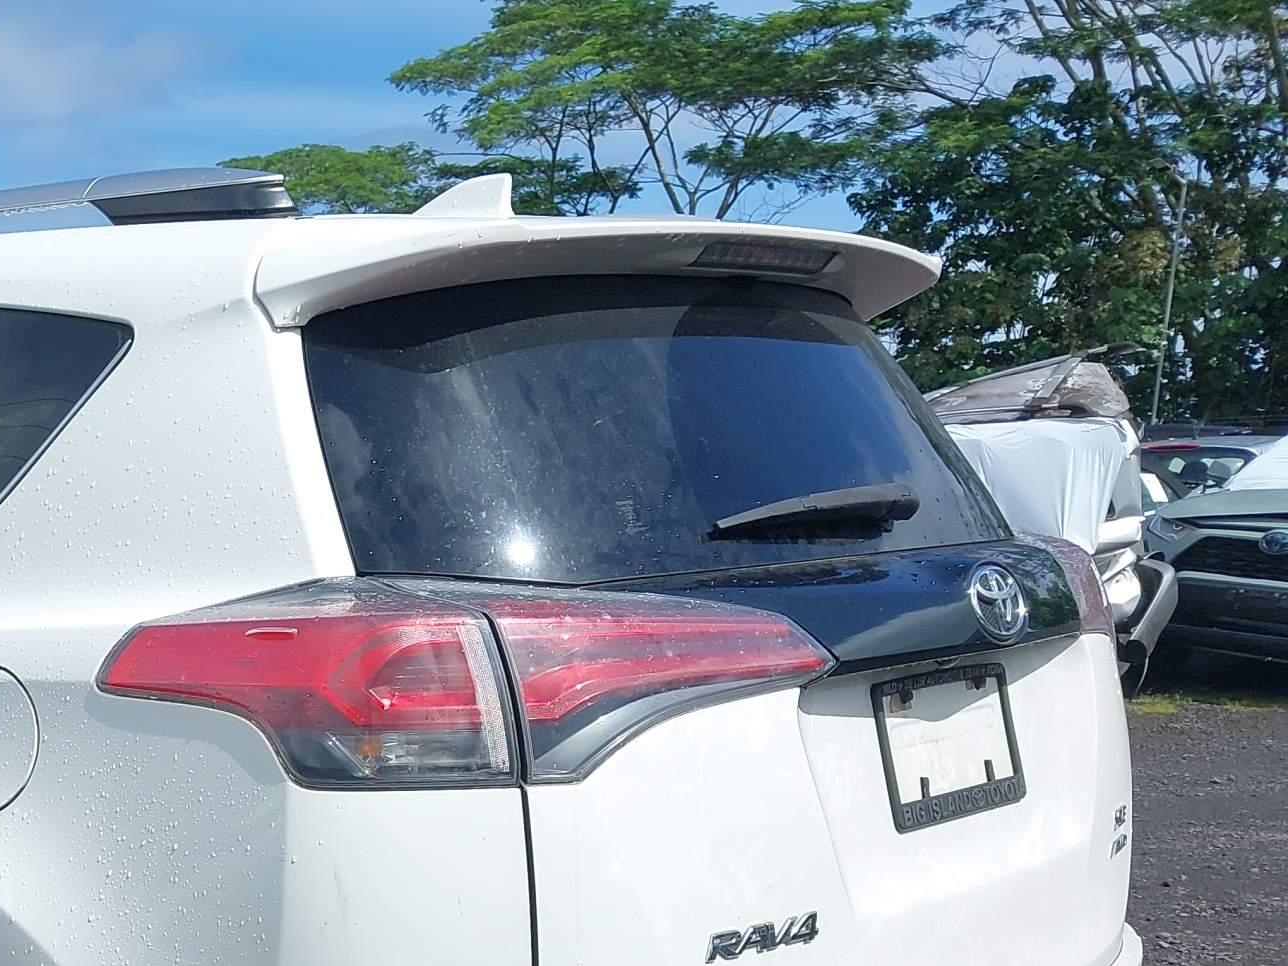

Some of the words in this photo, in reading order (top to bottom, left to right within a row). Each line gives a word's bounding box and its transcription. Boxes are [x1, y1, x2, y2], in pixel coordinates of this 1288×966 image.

[903, 804, 927, 827] BIG
[928, 790, 972, 822] ISLAND
[983, 778, 1025, 804] TOYOTA
[705, 910, 819, 965] RAV4
